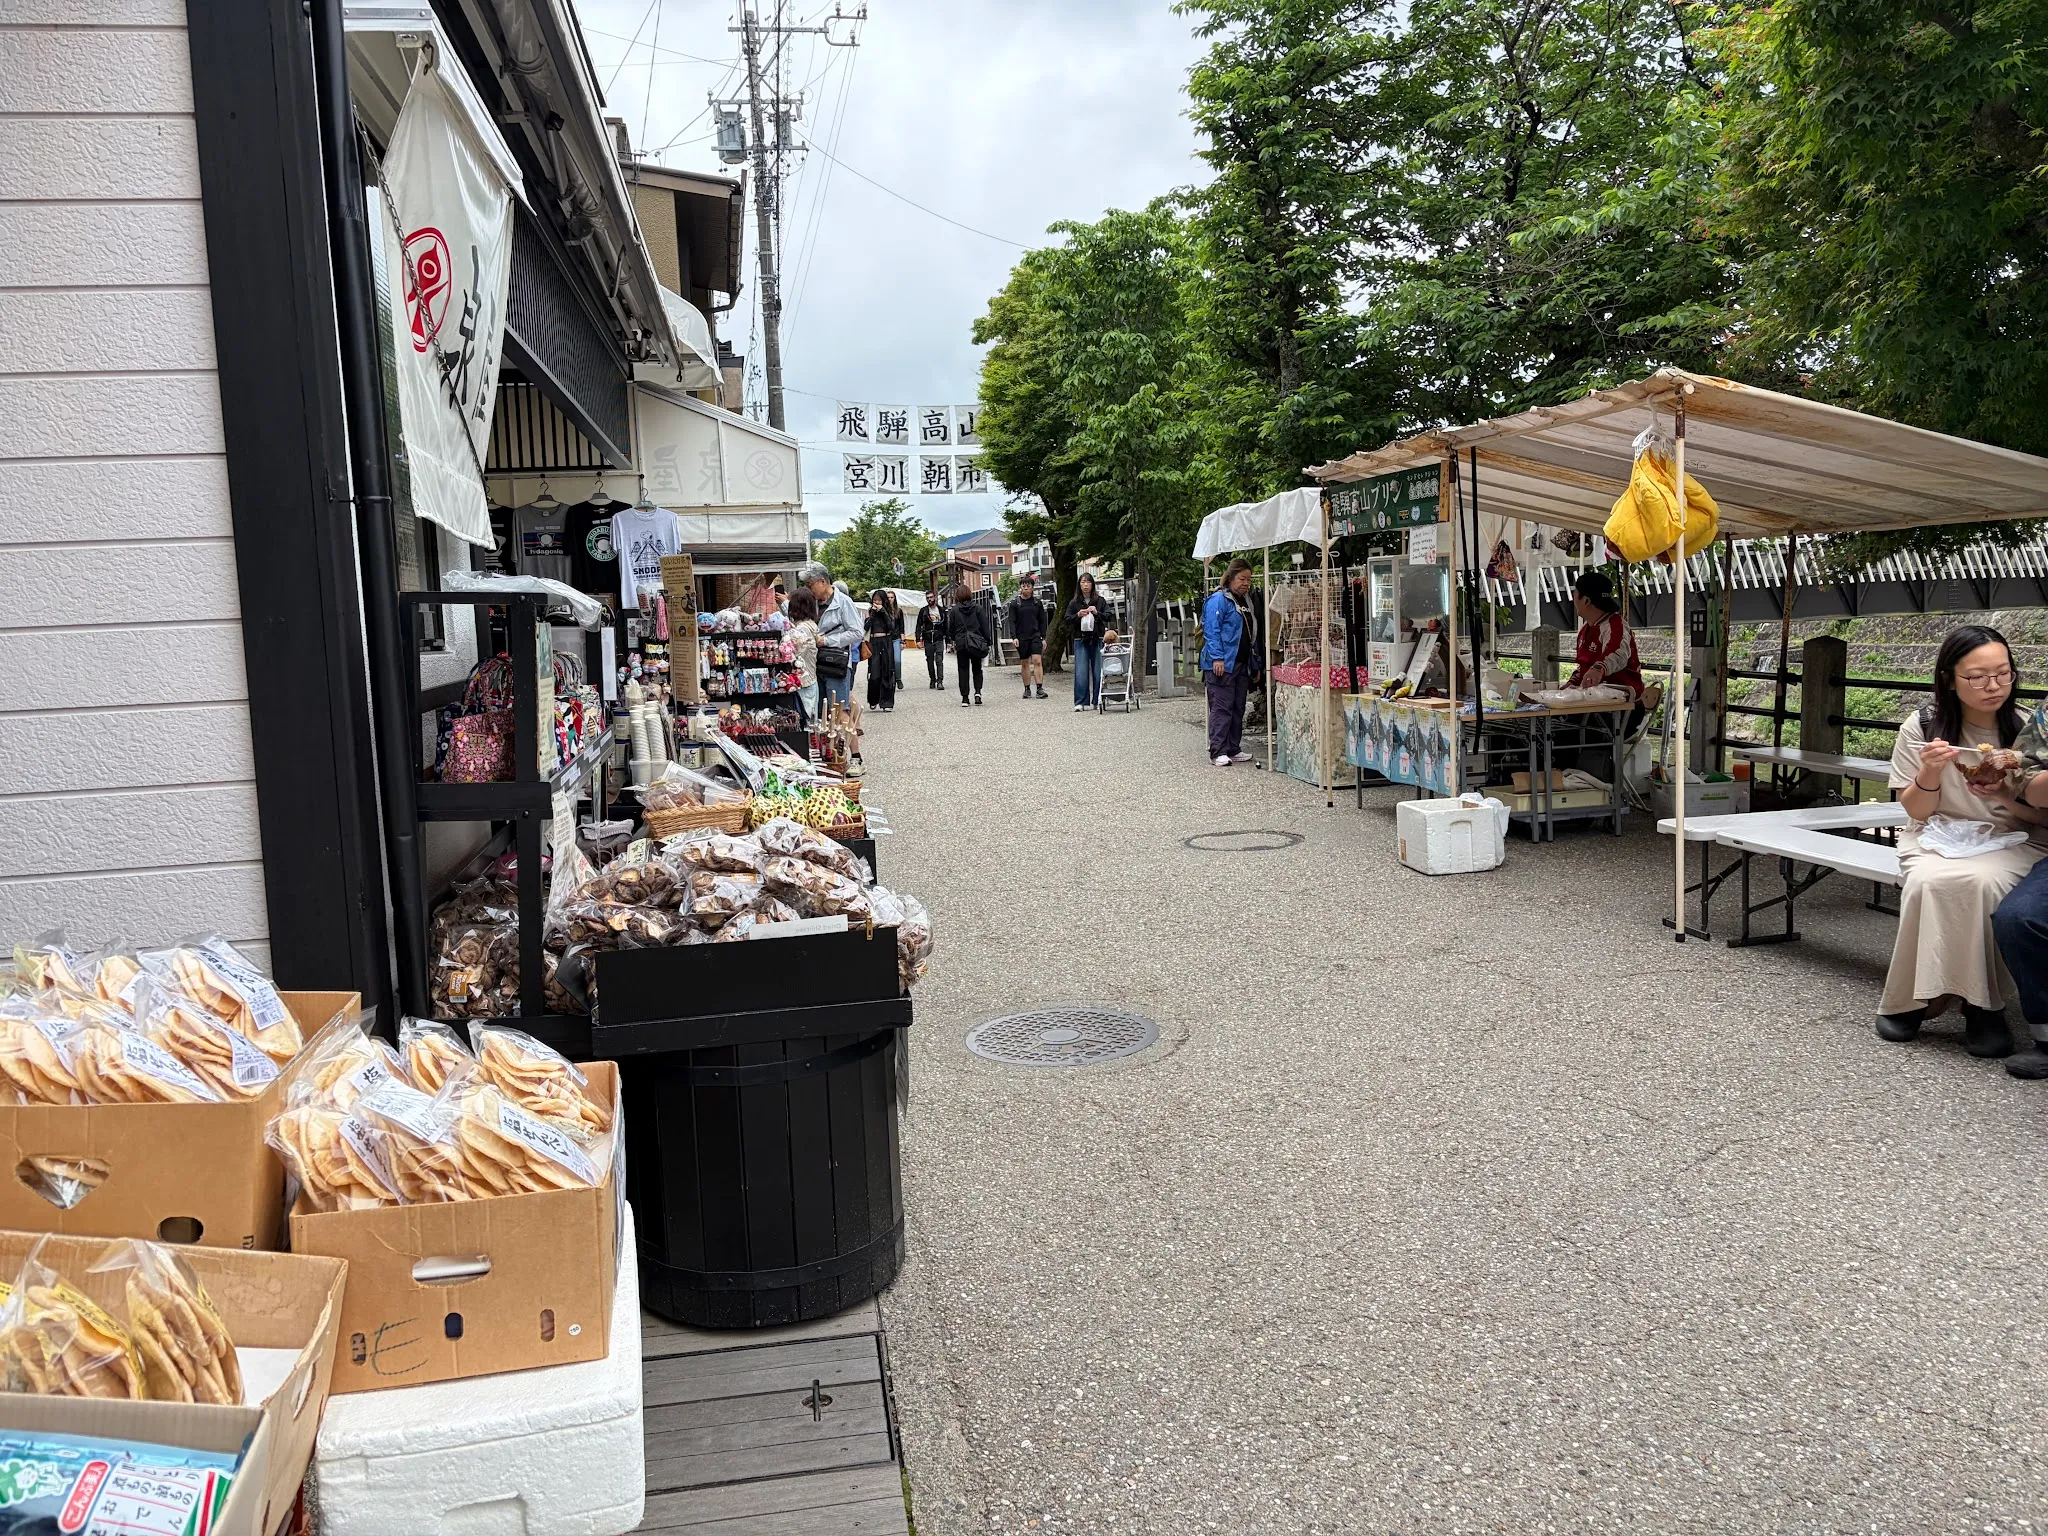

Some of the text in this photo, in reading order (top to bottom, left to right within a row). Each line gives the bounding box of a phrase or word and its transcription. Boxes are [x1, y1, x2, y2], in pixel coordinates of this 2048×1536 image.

[838, 406, 976, 442] 飛騨高山
[845, 458, 981, 490] 宮川朝市
[633, 566, 660, 575] SNOOP
[66, 1464, 107, 1523] こんぶ美人
[100, 1500, 183, 1531] おでん
